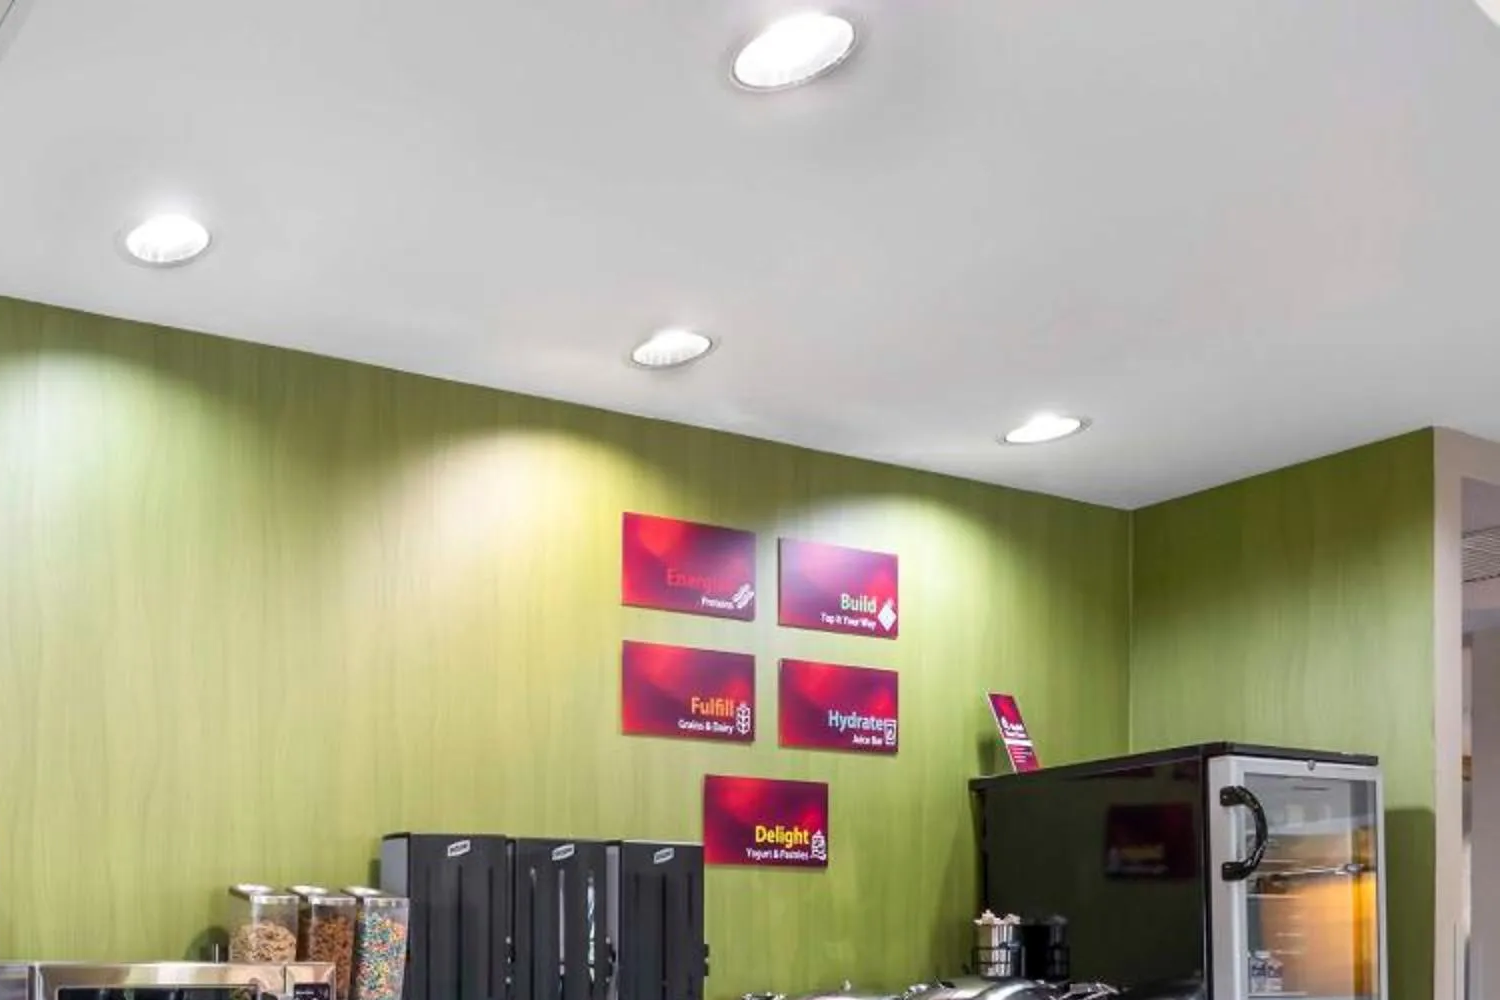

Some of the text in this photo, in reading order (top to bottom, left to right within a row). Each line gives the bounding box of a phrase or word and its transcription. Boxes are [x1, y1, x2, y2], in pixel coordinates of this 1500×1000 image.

[841, 593, 877, 613] Build
[691, 696, 734, 717] Fulfill
[828, 709, 883, 732] Hydrate
[755, 825, 810, 849] Delight
